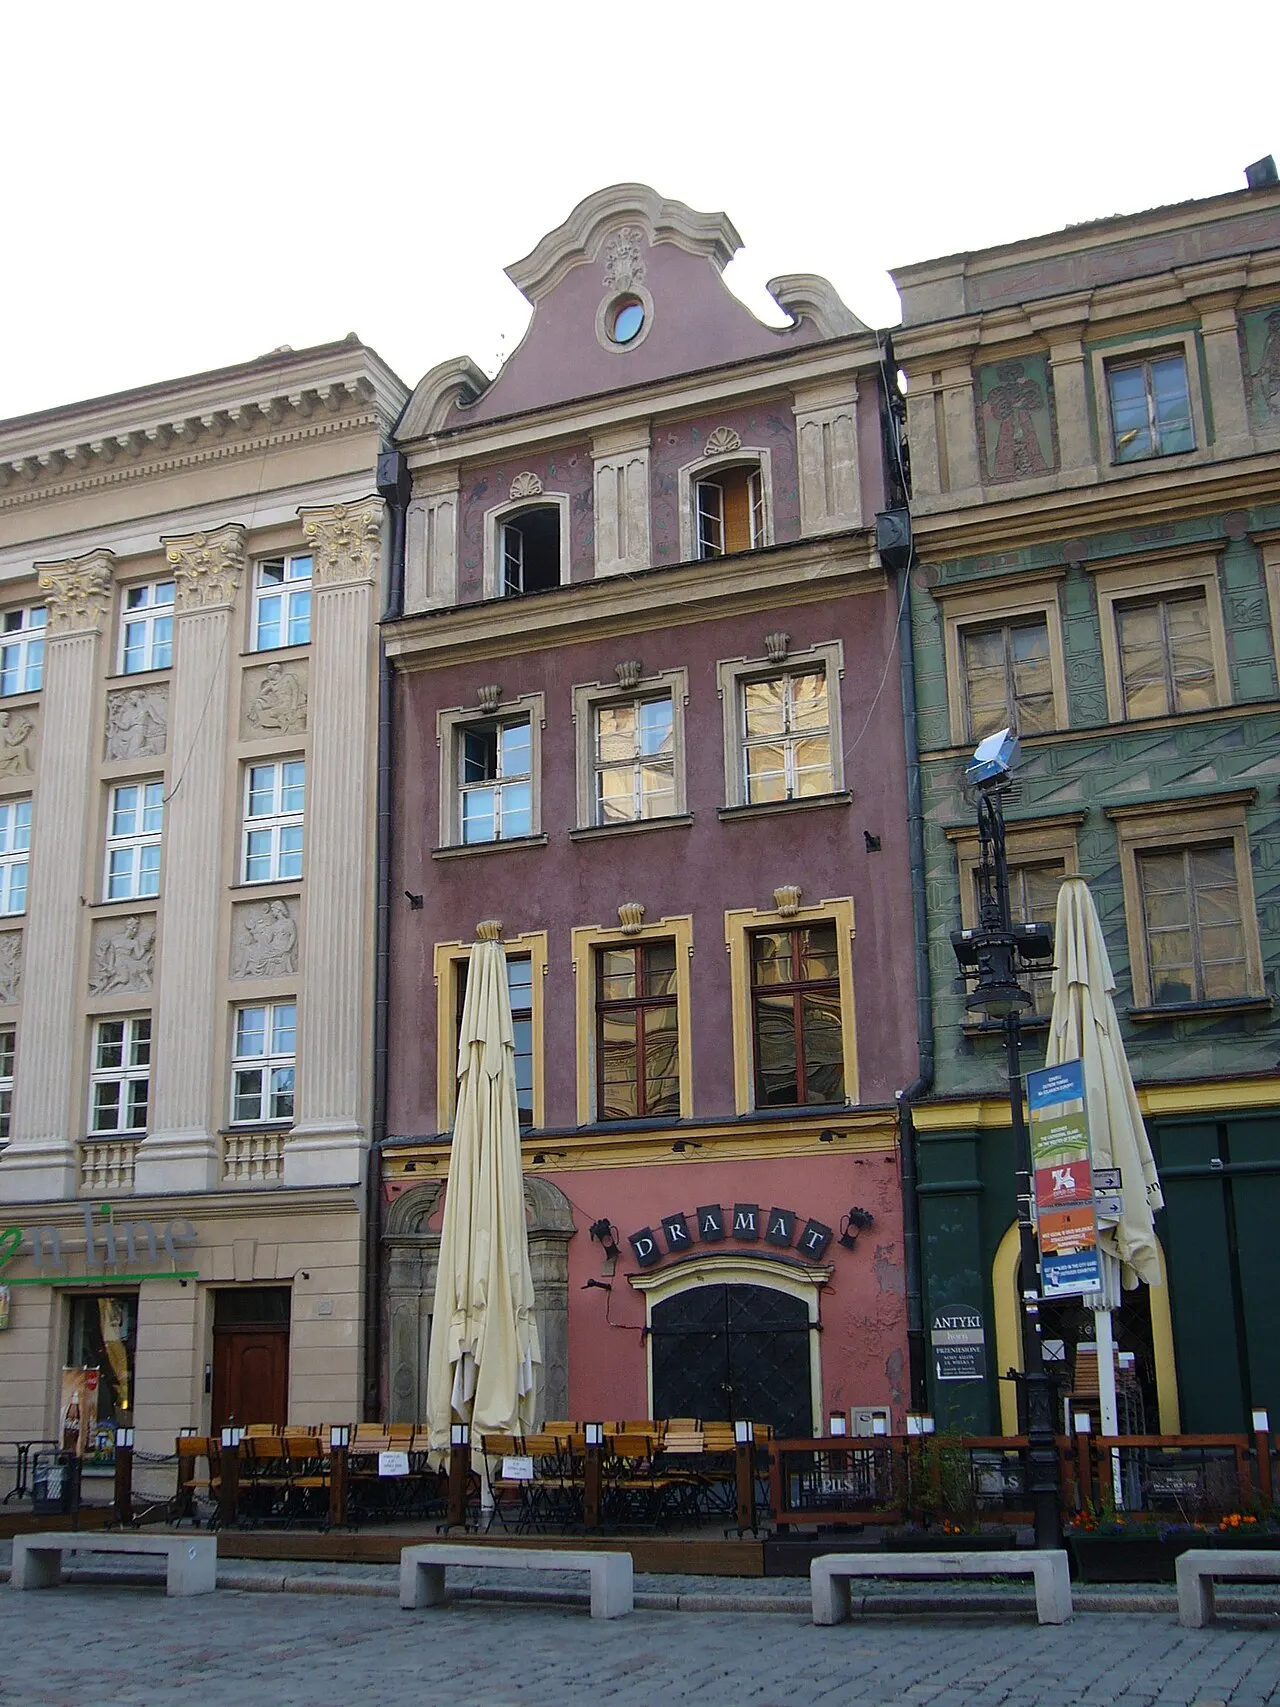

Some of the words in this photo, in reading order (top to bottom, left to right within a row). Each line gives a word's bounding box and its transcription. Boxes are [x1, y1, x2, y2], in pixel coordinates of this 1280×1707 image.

[80, 1202, 197, 1266] line
[635, 1213, 824, 1258] DRAMAT
[934, 1316, 980, 1328] ANTYKI
